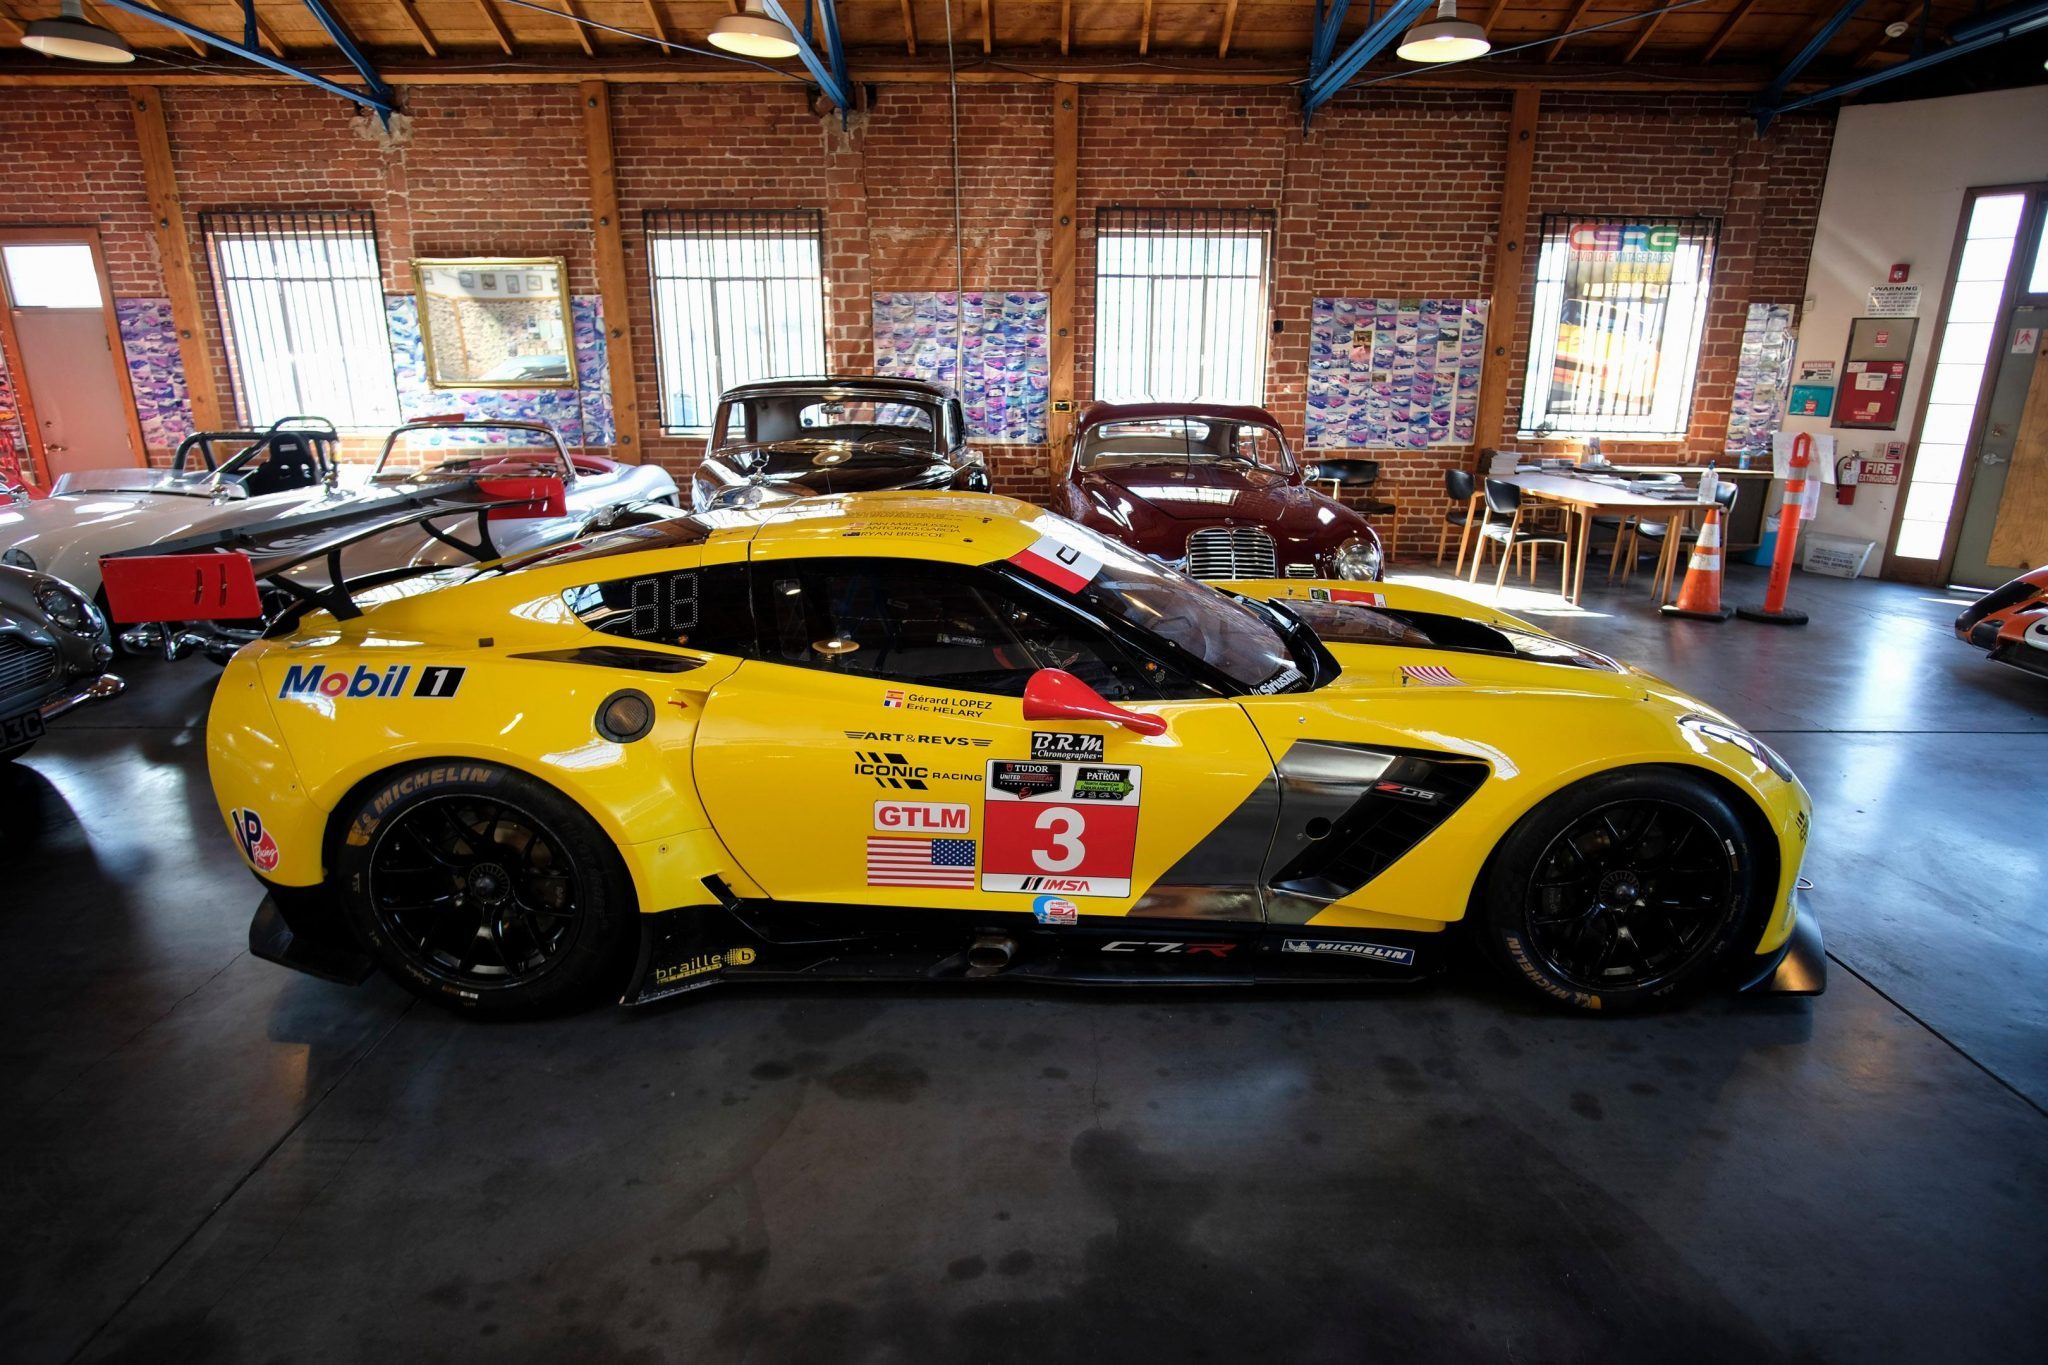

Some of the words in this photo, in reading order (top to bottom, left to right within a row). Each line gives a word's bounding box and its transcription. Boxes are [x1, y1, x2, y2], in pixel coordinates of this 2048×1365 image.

[1569, 224, 1679, 252] CSRG
[1865, 462, 1894, 475] FIRE
[1859, 474, 1897, 483] EXTINGUISHER
[279, 664, 411, 698] Mobil
[430, 669, 449, 696] 1
[906, 703, 930, 712] Eric
[933, 706, 984, 718] HELARY
[908, 693, 949, 705] Gérard
[951, 698, 993, 710] LOPEZ
[1037, 750, 1098, 761] Chronographes
[854, 763, 929, 779] ICONIC
[932, 772, 983, 782] RACING
[1014, 764, 1049, 773] TUDOR
[1086, 771, 1121, 781] PATRÓN
[373, 766, 493, 815] MICHELIN
[878, 805, 967, 830] GTLM
[231, 808, 263, 865] VP
[1031, 806, 1086, 873] 3
[1043, 878, 1091, 892] IMSA
[1050, 908, 1076, 918] 24
[1315, 942, 1408, 960] MICHELIN
[656, 953, 722, 980] braille
[1505, 937, 1570, 1000] MICHELIN
